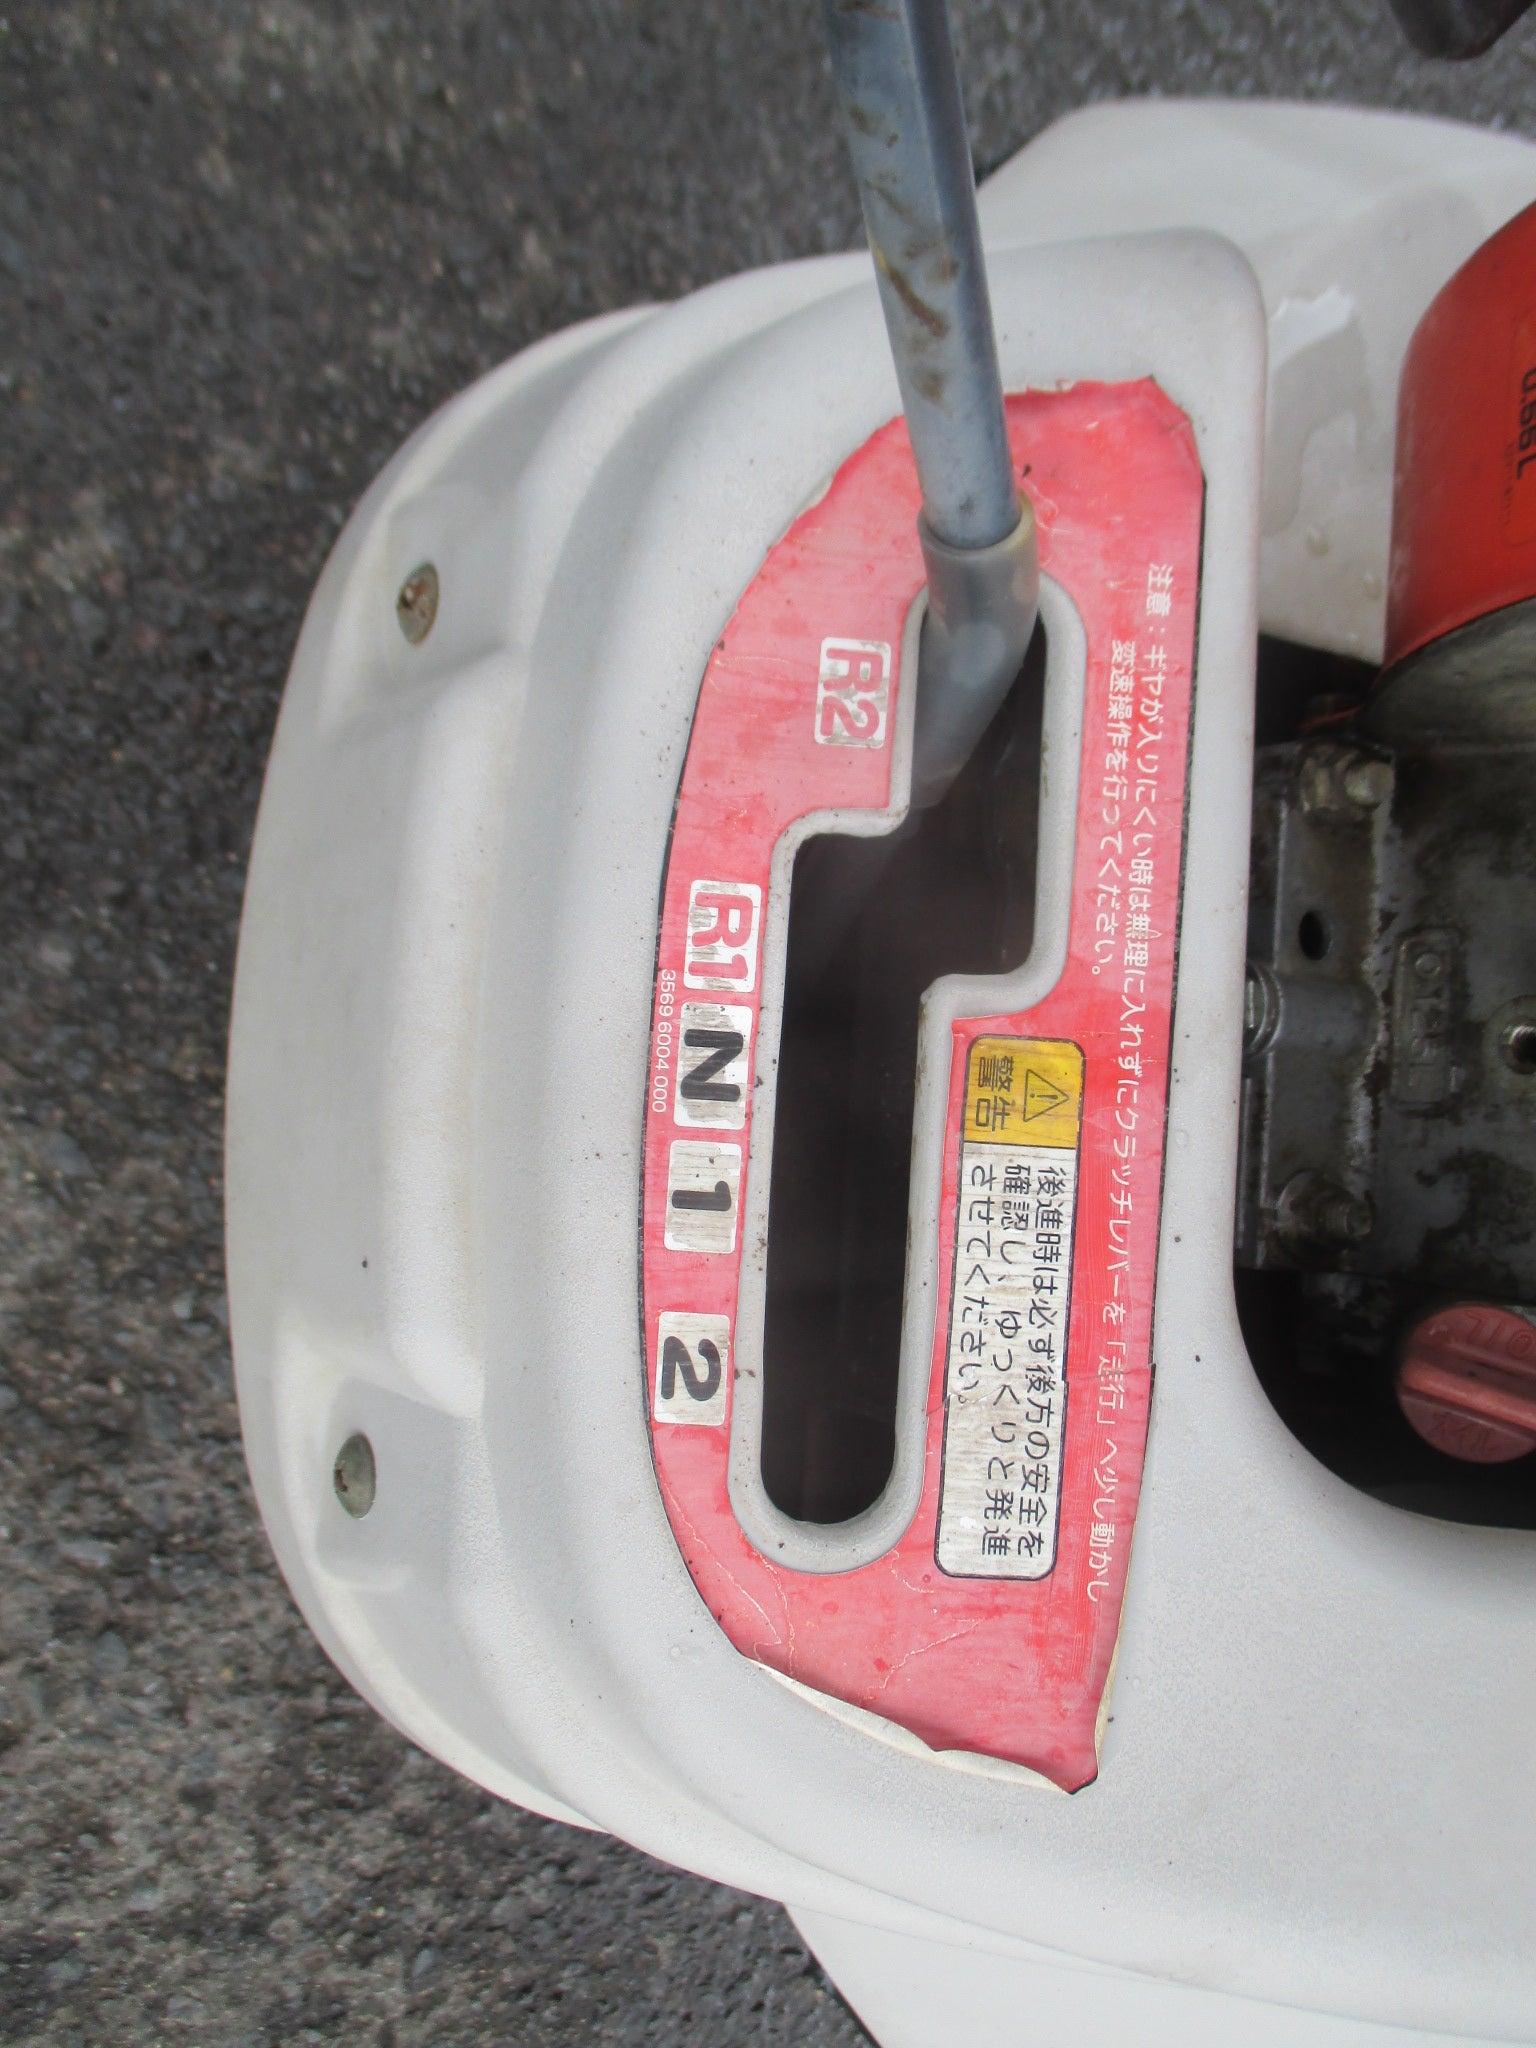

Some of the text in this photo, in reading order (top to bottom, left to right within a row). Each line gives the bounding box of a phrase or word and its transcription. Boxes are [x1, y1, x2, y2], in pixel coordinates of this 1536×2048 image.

[820, 647, 884, 740] R2
[1091, 639, 1136, 976] 変速操作を行ってください。
[687, 891, 753, 979] R1
[652, 968, 677, 1113] 3569 6004 000
[680, 1028, 744, 1102] N
[976, 1055, 1015, 1132] 警告
[671, 1180, 732, 1212] 1
[957, 1164, 997, 1405] させてください。
[660, 1336, 722, 1402] 2
[981, 1164, 1031, 1556] 確認し、ゆっくりと発進
[1017, 1165, 1067, 1558] 後進時は必ず後方の安全を
